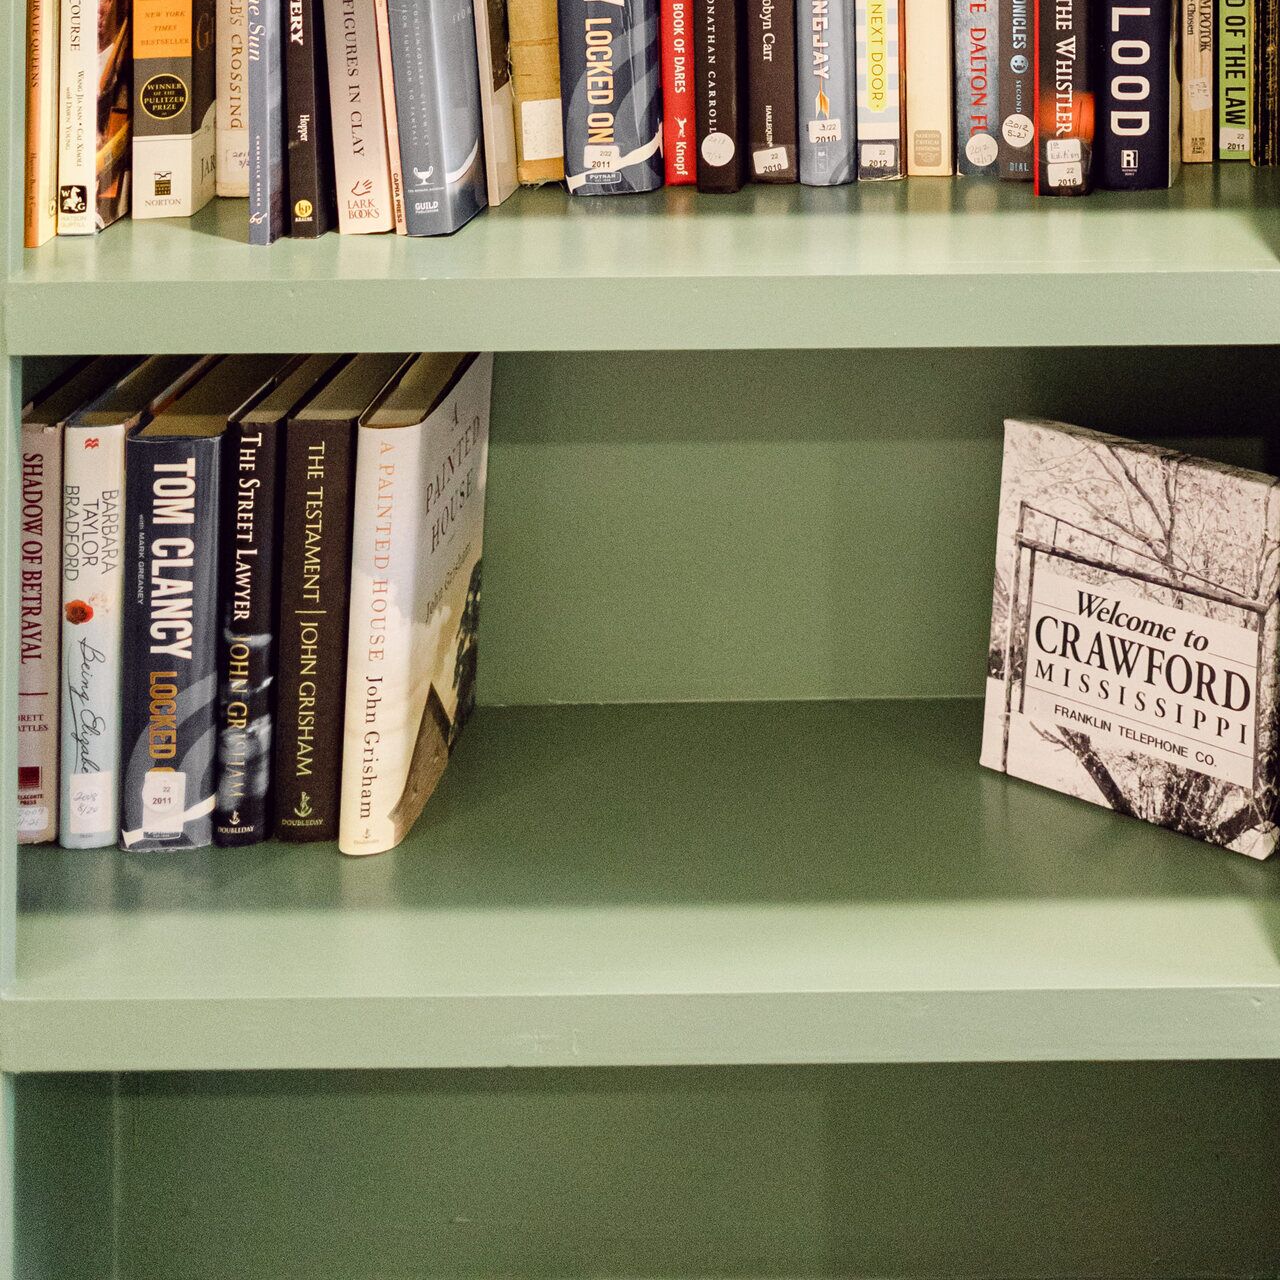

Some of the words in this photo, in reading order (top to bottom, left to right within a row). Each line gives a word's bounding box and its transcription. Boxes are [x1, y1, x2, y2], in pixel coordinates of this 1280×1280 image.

[762, 31, 775, 62] Carr
[299, 114, 311, 142] Hopper
[592, 160, 611, 169] 2011
[348, 199, 375, 208] LARK
[348, 209, 380, 220] BOOKS
[306, 440, 325, 479] THE
[64, 485, 80, 582] BRADFORD
[81, 498, 99, 568] TAYLOR
[101, 489, 120, 575] BARBARA
[302, 482, 325, 604] TESTAMENT
[1077, 589, 1177, 642] Welcome
[1183, 630, 1210, 653] to
[1035, 615, 1251, 712] CRAWFORD
[1035, 658, 1248, 745] MISSISSIPPI
[1054, 704, 1112, 732] FRANKLIN
[1118, 725, 1189, 759] TELEPHONE
[1195, 751, 1218, 768] CO.
[152, 796, 172, 805] 2011
